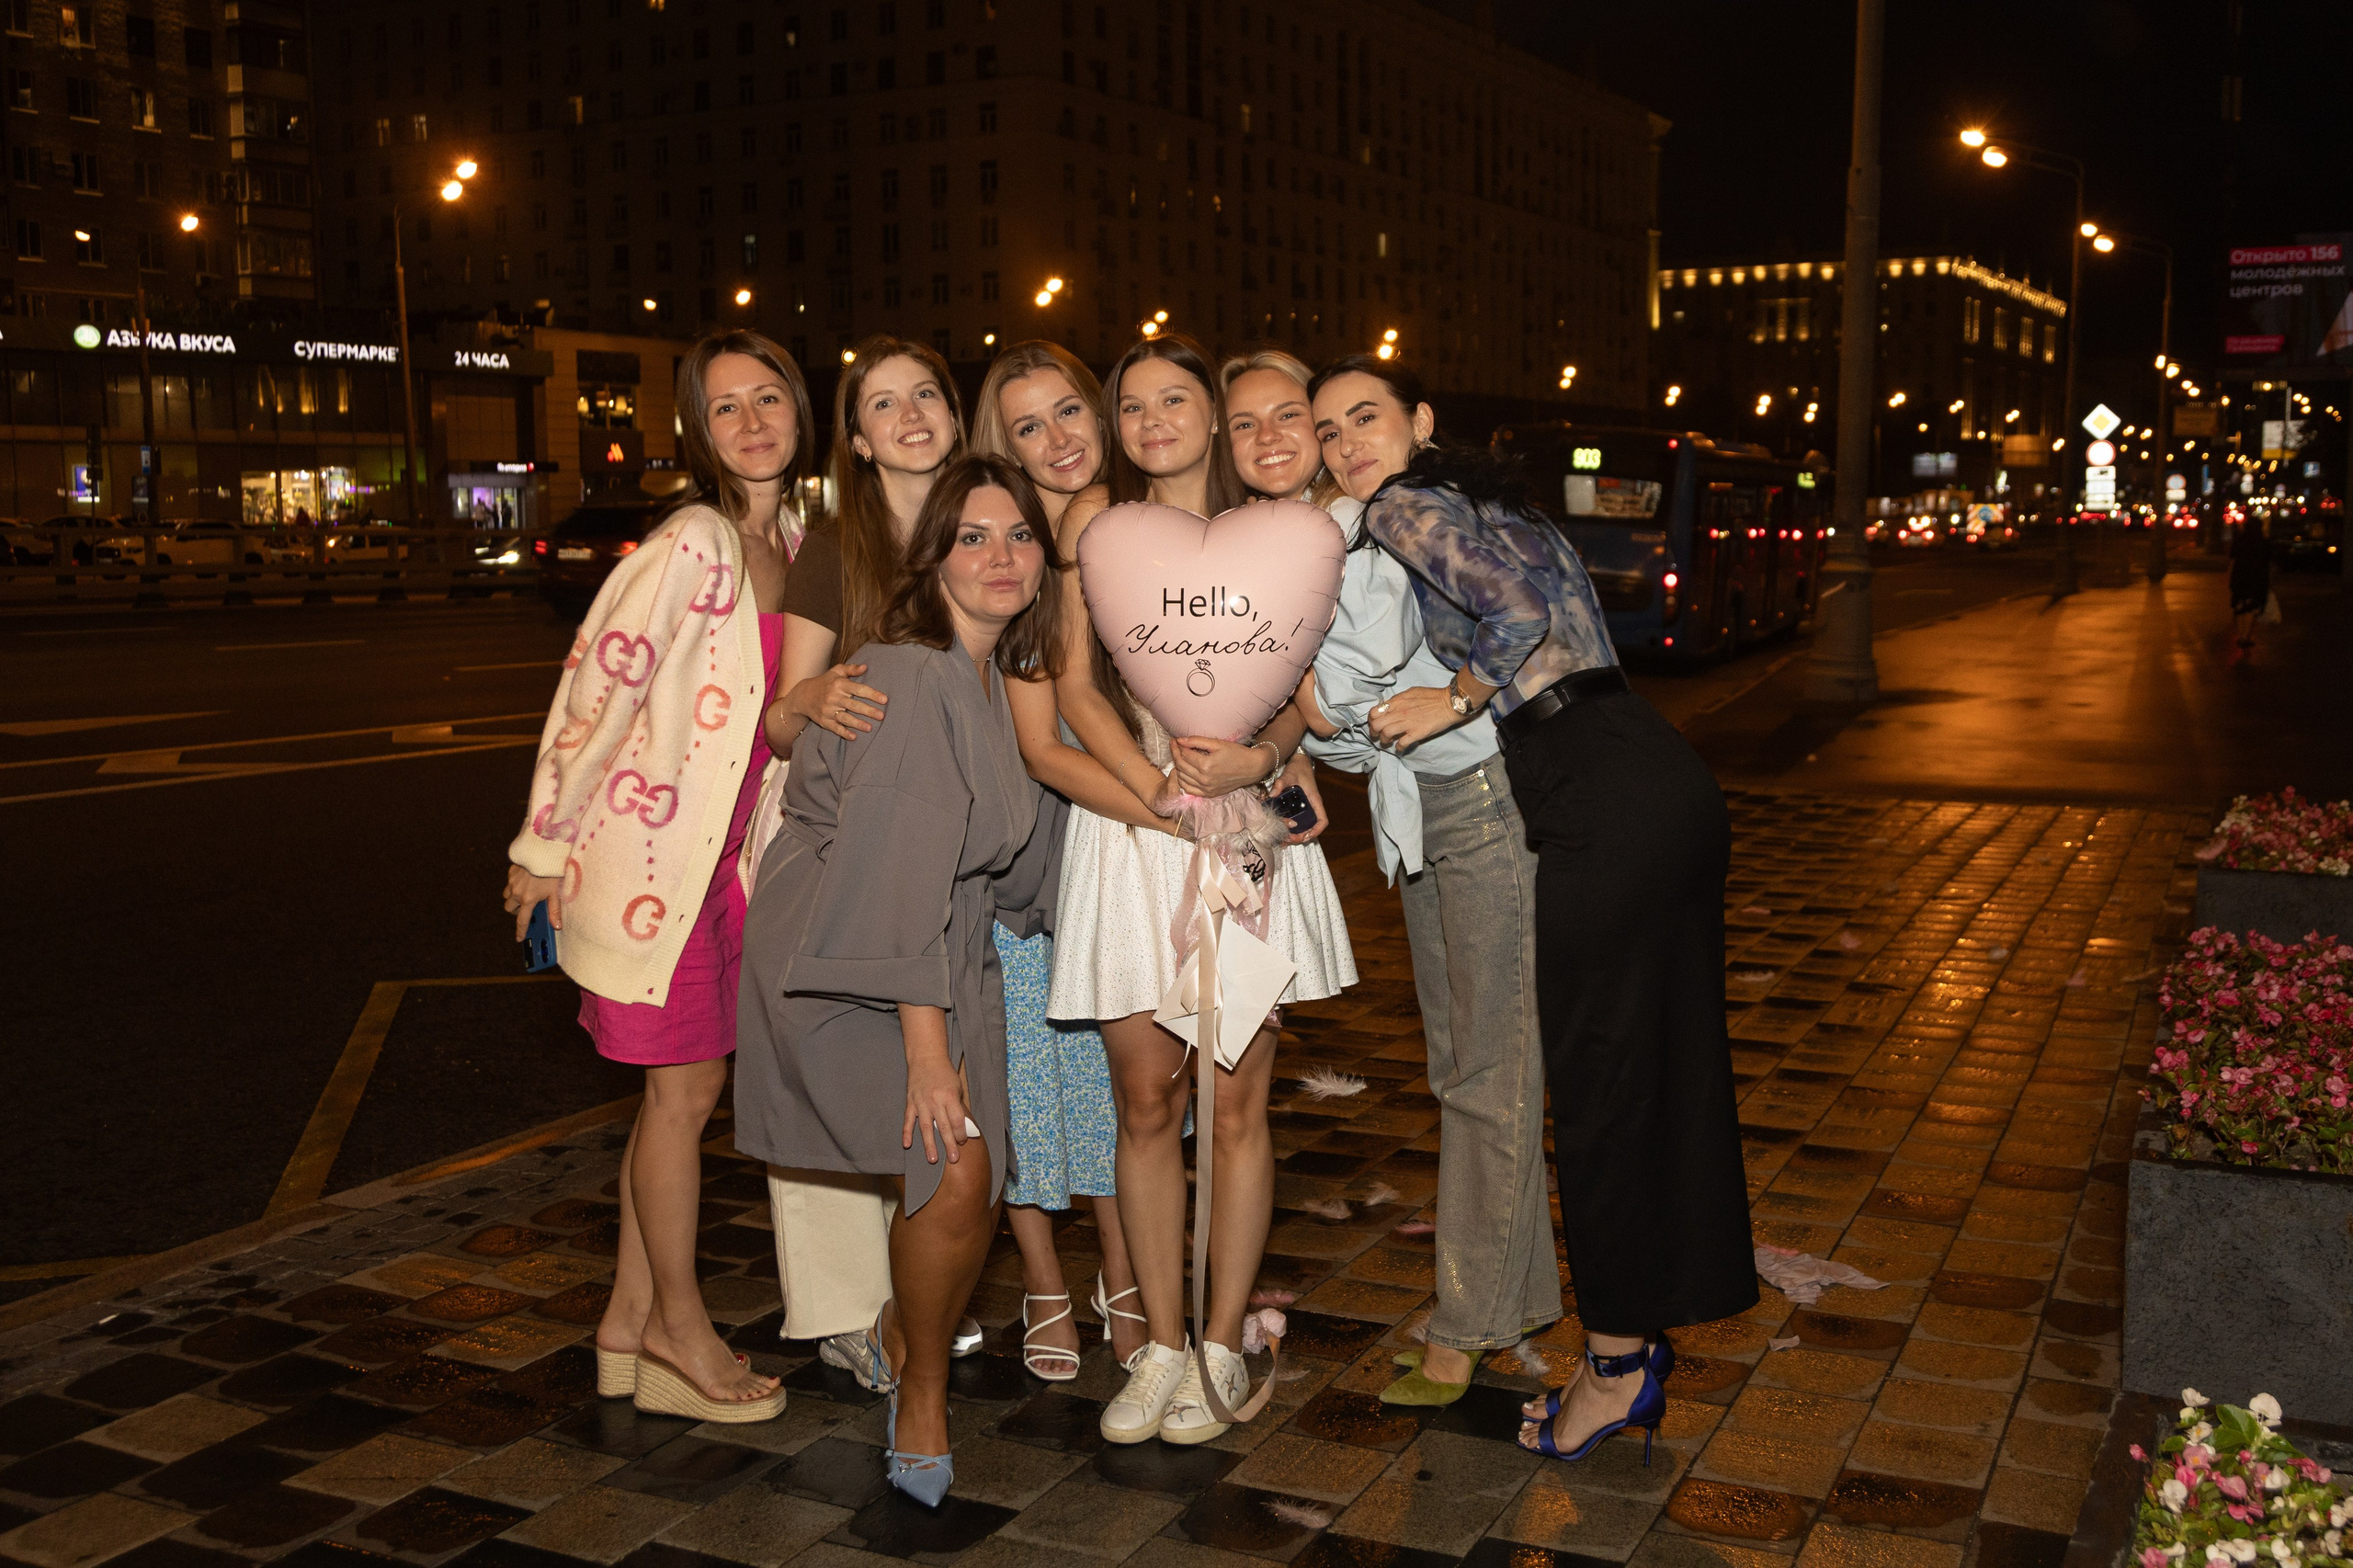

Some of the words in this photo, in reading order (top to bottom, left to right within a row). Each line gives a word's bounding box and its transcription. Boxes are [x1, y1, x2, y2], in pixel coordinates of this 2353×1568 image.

[2231, 250, 2306, 265] Открыто
[2310, 245, 2339, 261] 156
[2230, 265, 2346, 280] молодёжных
[2229, 284, 2303, 299] центров
[179, 333, 236, 354] ВКУСА
[293, 340, 399, 363] СУПЕРМАРКЕ
[454, 350, 470, 367] 24
[471, 352, 510, 369] ЧАСА
[1163, 585, 1258, 622] Hello,
[1125, 618, 1304, 656] Уланова!
